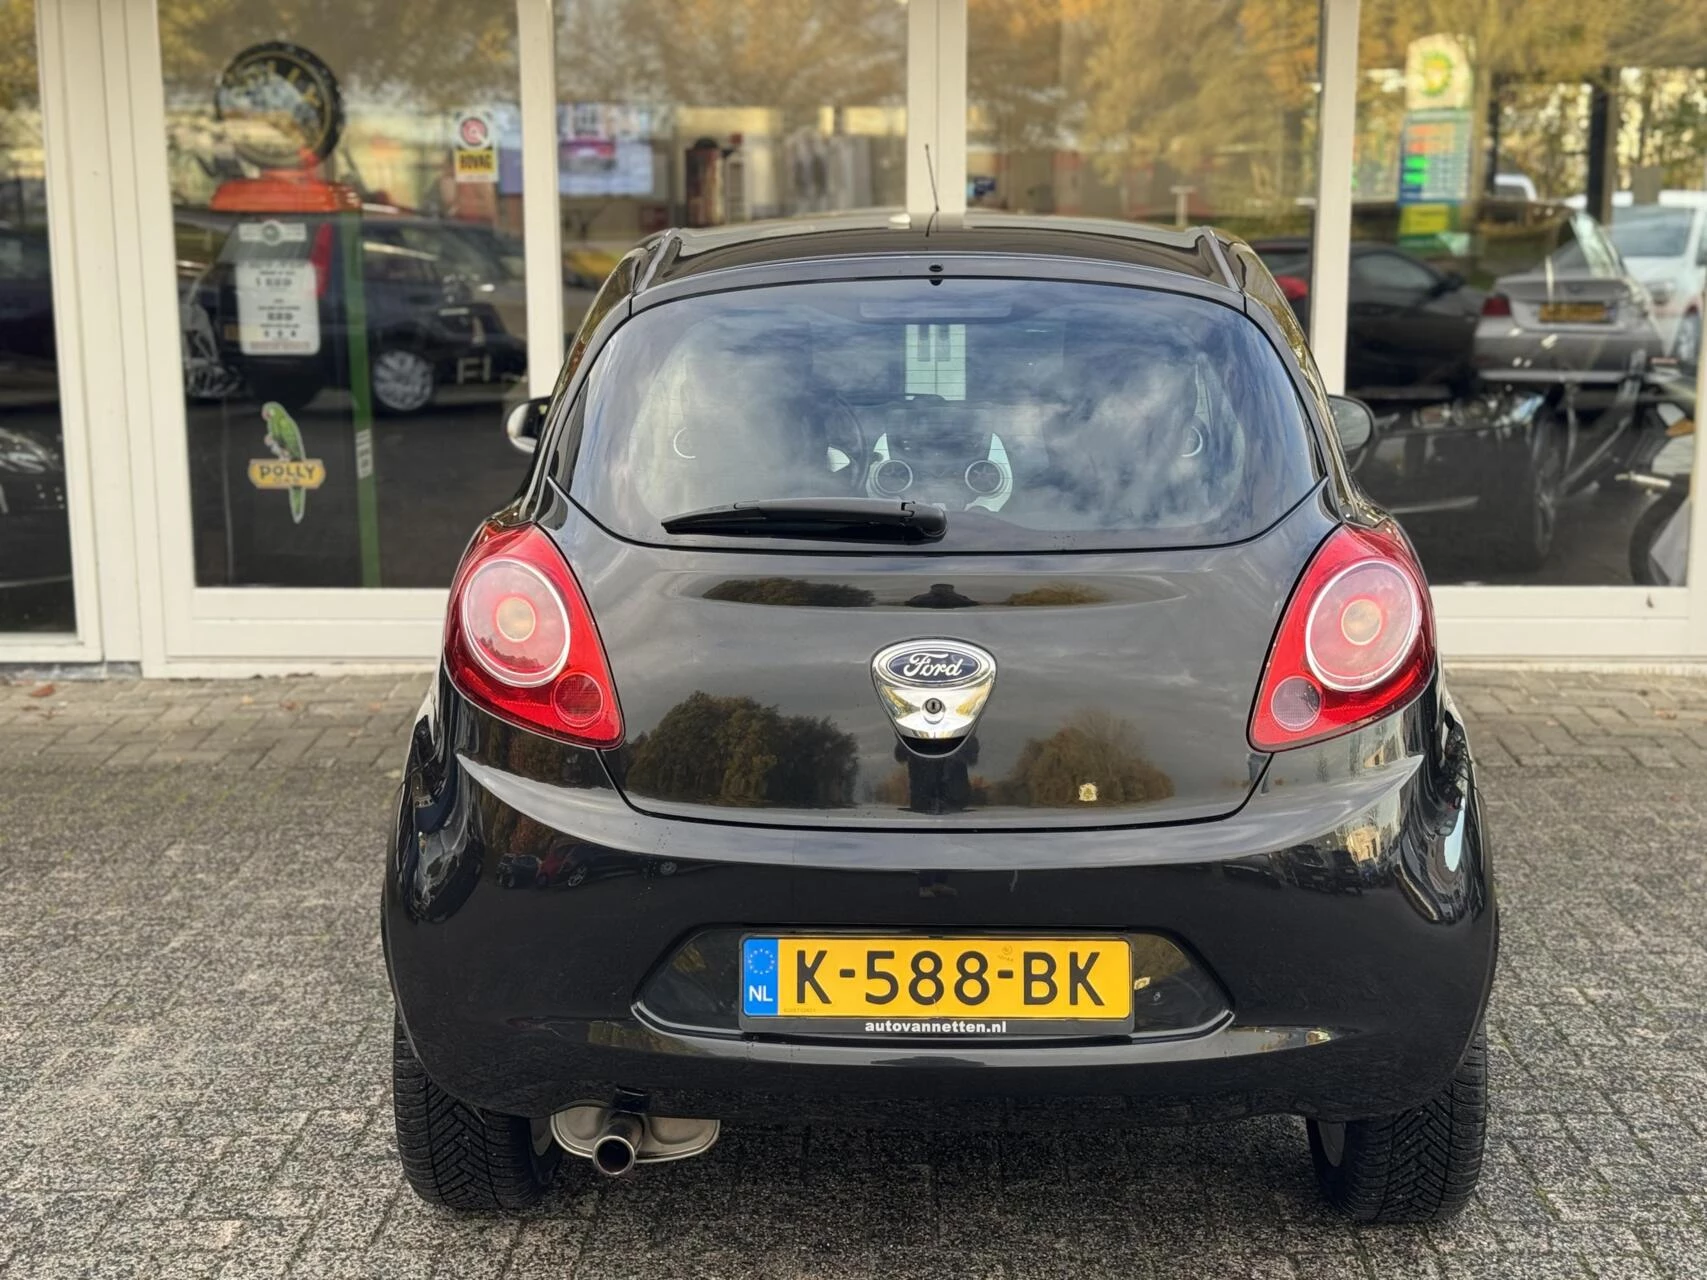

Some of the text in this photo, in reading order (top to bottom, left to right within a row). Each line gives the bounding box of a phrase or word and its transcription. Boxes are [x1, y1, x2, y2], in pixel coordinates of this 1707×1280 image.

[260, 465, 316, 480] POLLY
[903, 652, 963, 677] Ford
[796, 949, 1105, 1006] K-588-BK
[749, 985, 774, 1002] NL
[865, 1019, 1007, 1033] autovannetten.nl
